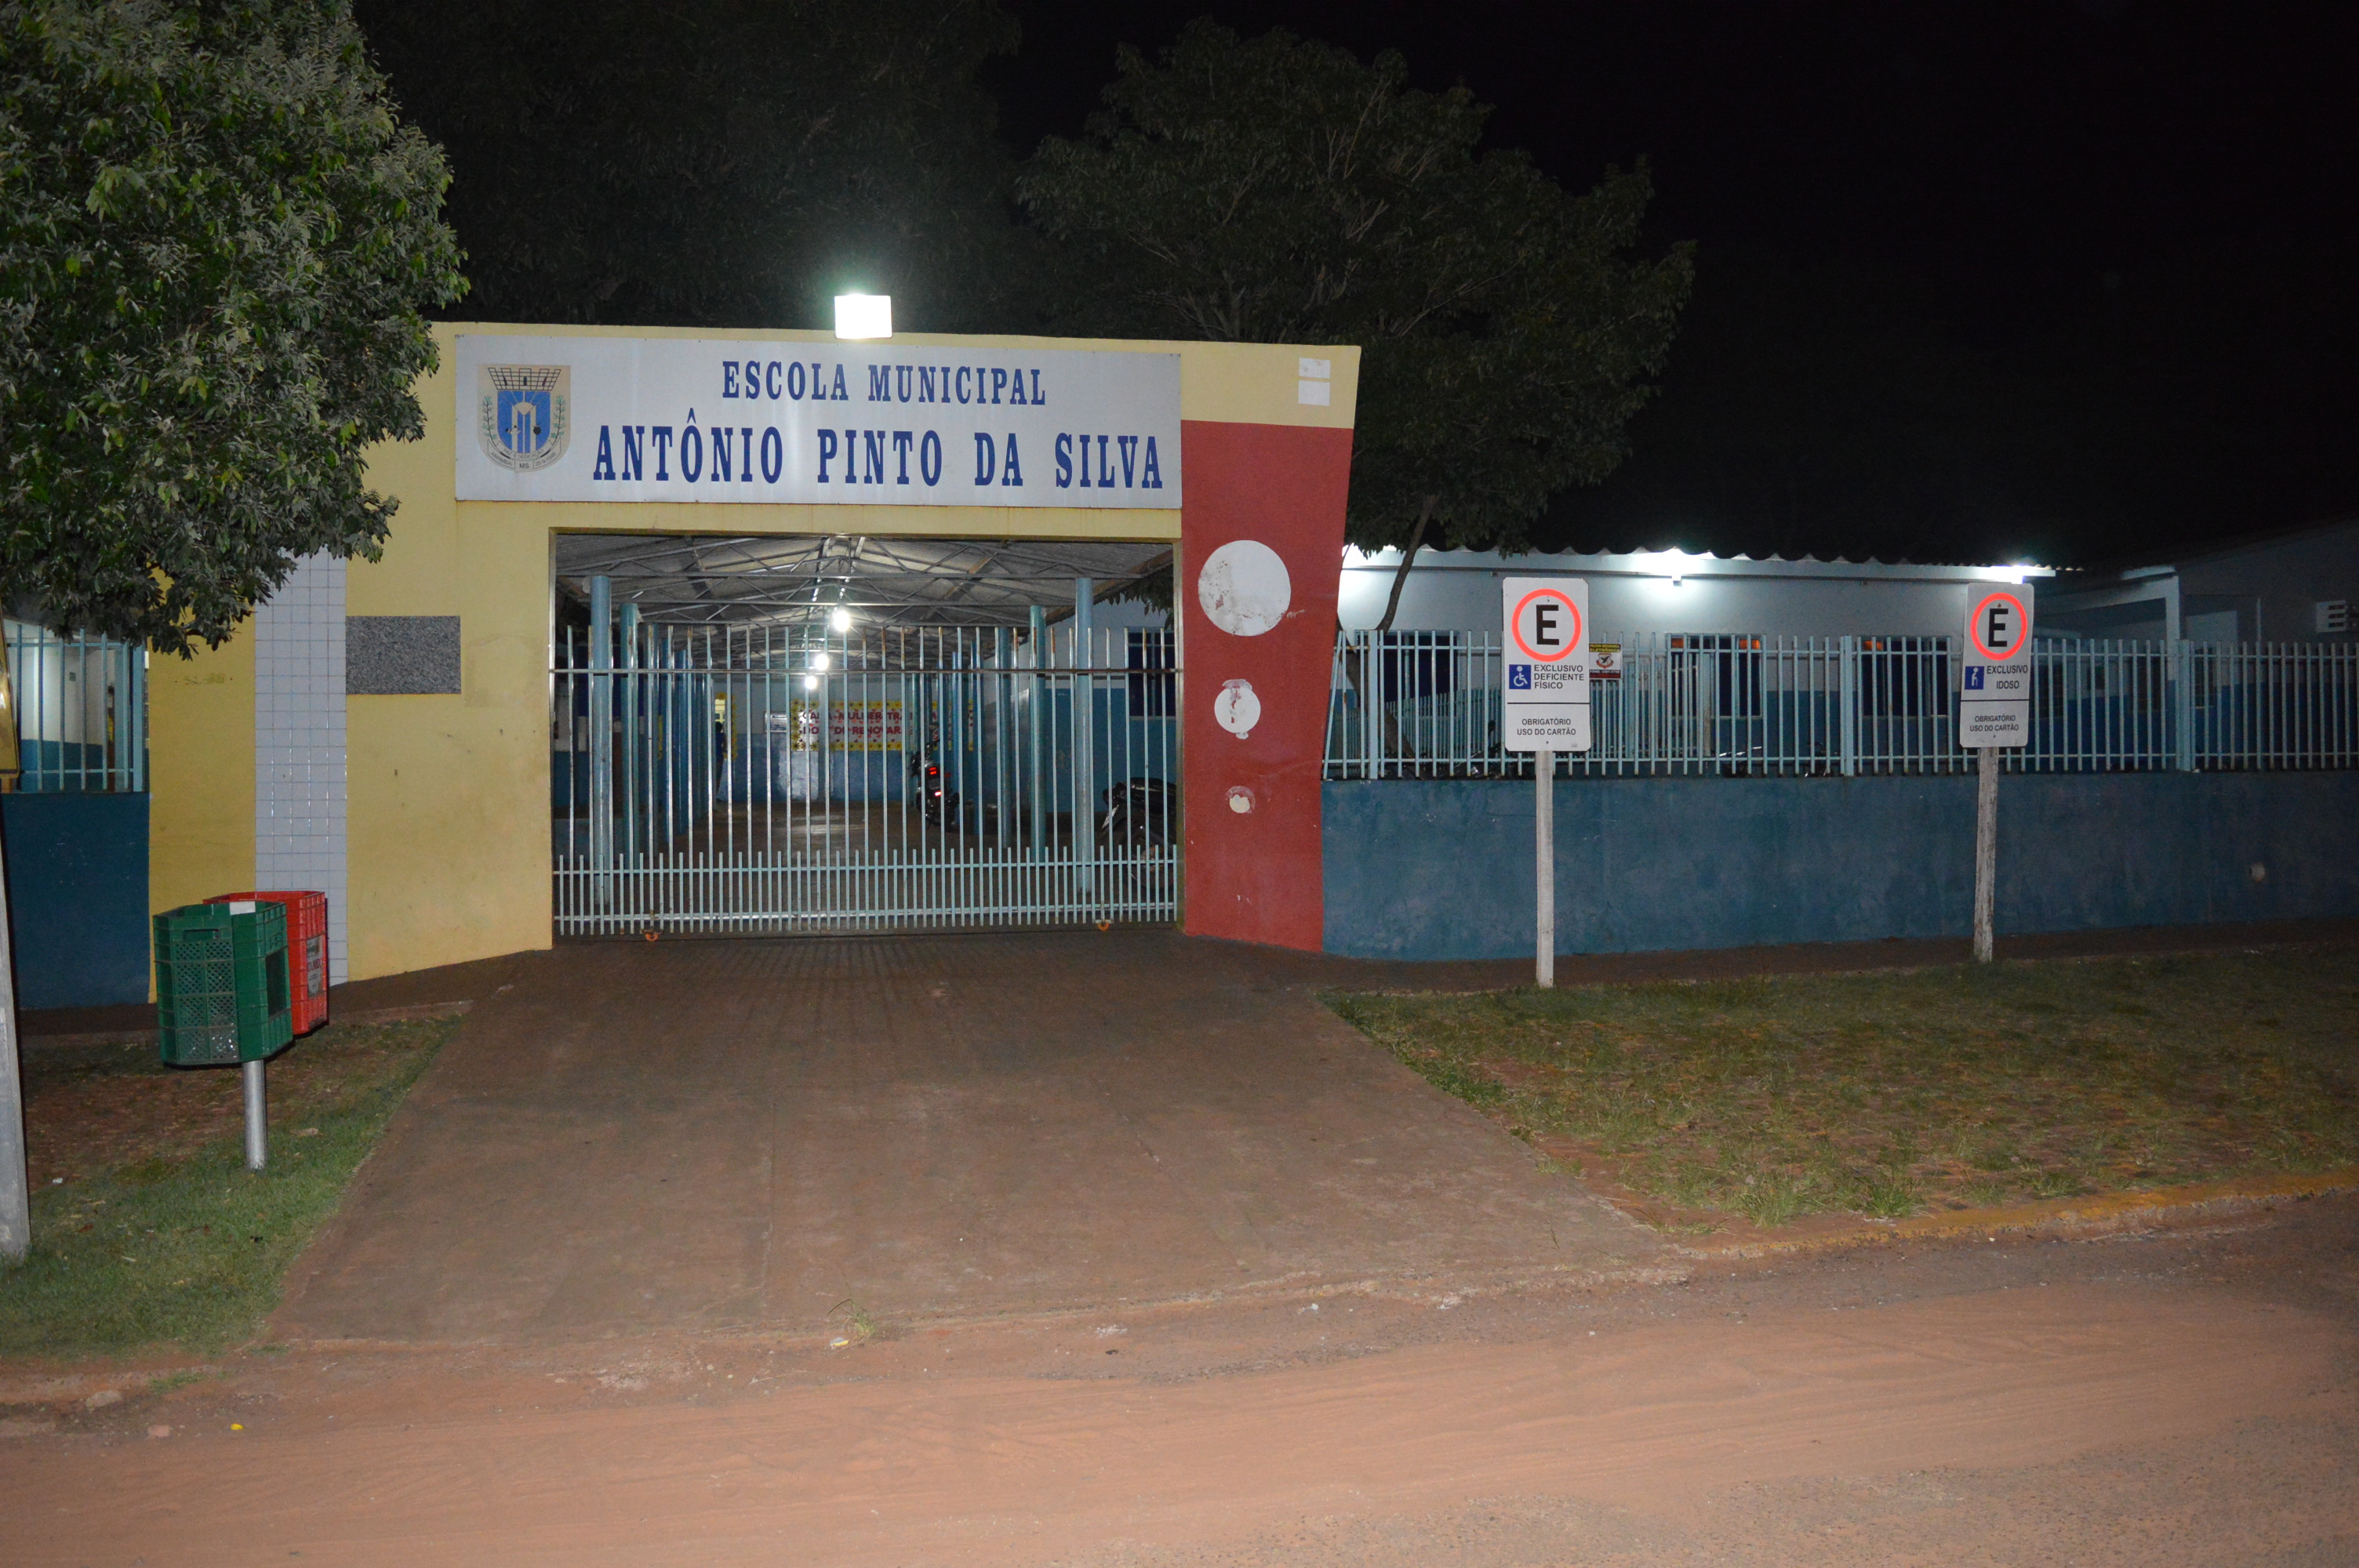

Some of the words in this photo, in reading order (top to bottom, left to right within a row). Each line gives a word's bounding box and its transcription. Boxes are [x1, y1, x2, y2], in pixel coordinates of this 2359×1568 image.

[721, 360, 849, 401] ESCOLA
[867, 364, 1046, 406] MUNICIPAL
[592, 408, 783, 485] ANTÔNIO
[816, 428, 943, 488] PINTO
[974, 432, 1024, 487] DA
[1055, 433, 1164, 490] SILVA
[1536, 604, 1560, 646] E
[1987, 608, 2009, 648] E
[1986, 665, 2029, 674] EXCLUSIVO
[1534, 681, 1563, 689] FÍSICO
[1996, 681, 2019, 689] IDOSO
[1547, 727, 1576, 735] CARTÃO
[1994, 723, 2019, 731] CARTÃO
